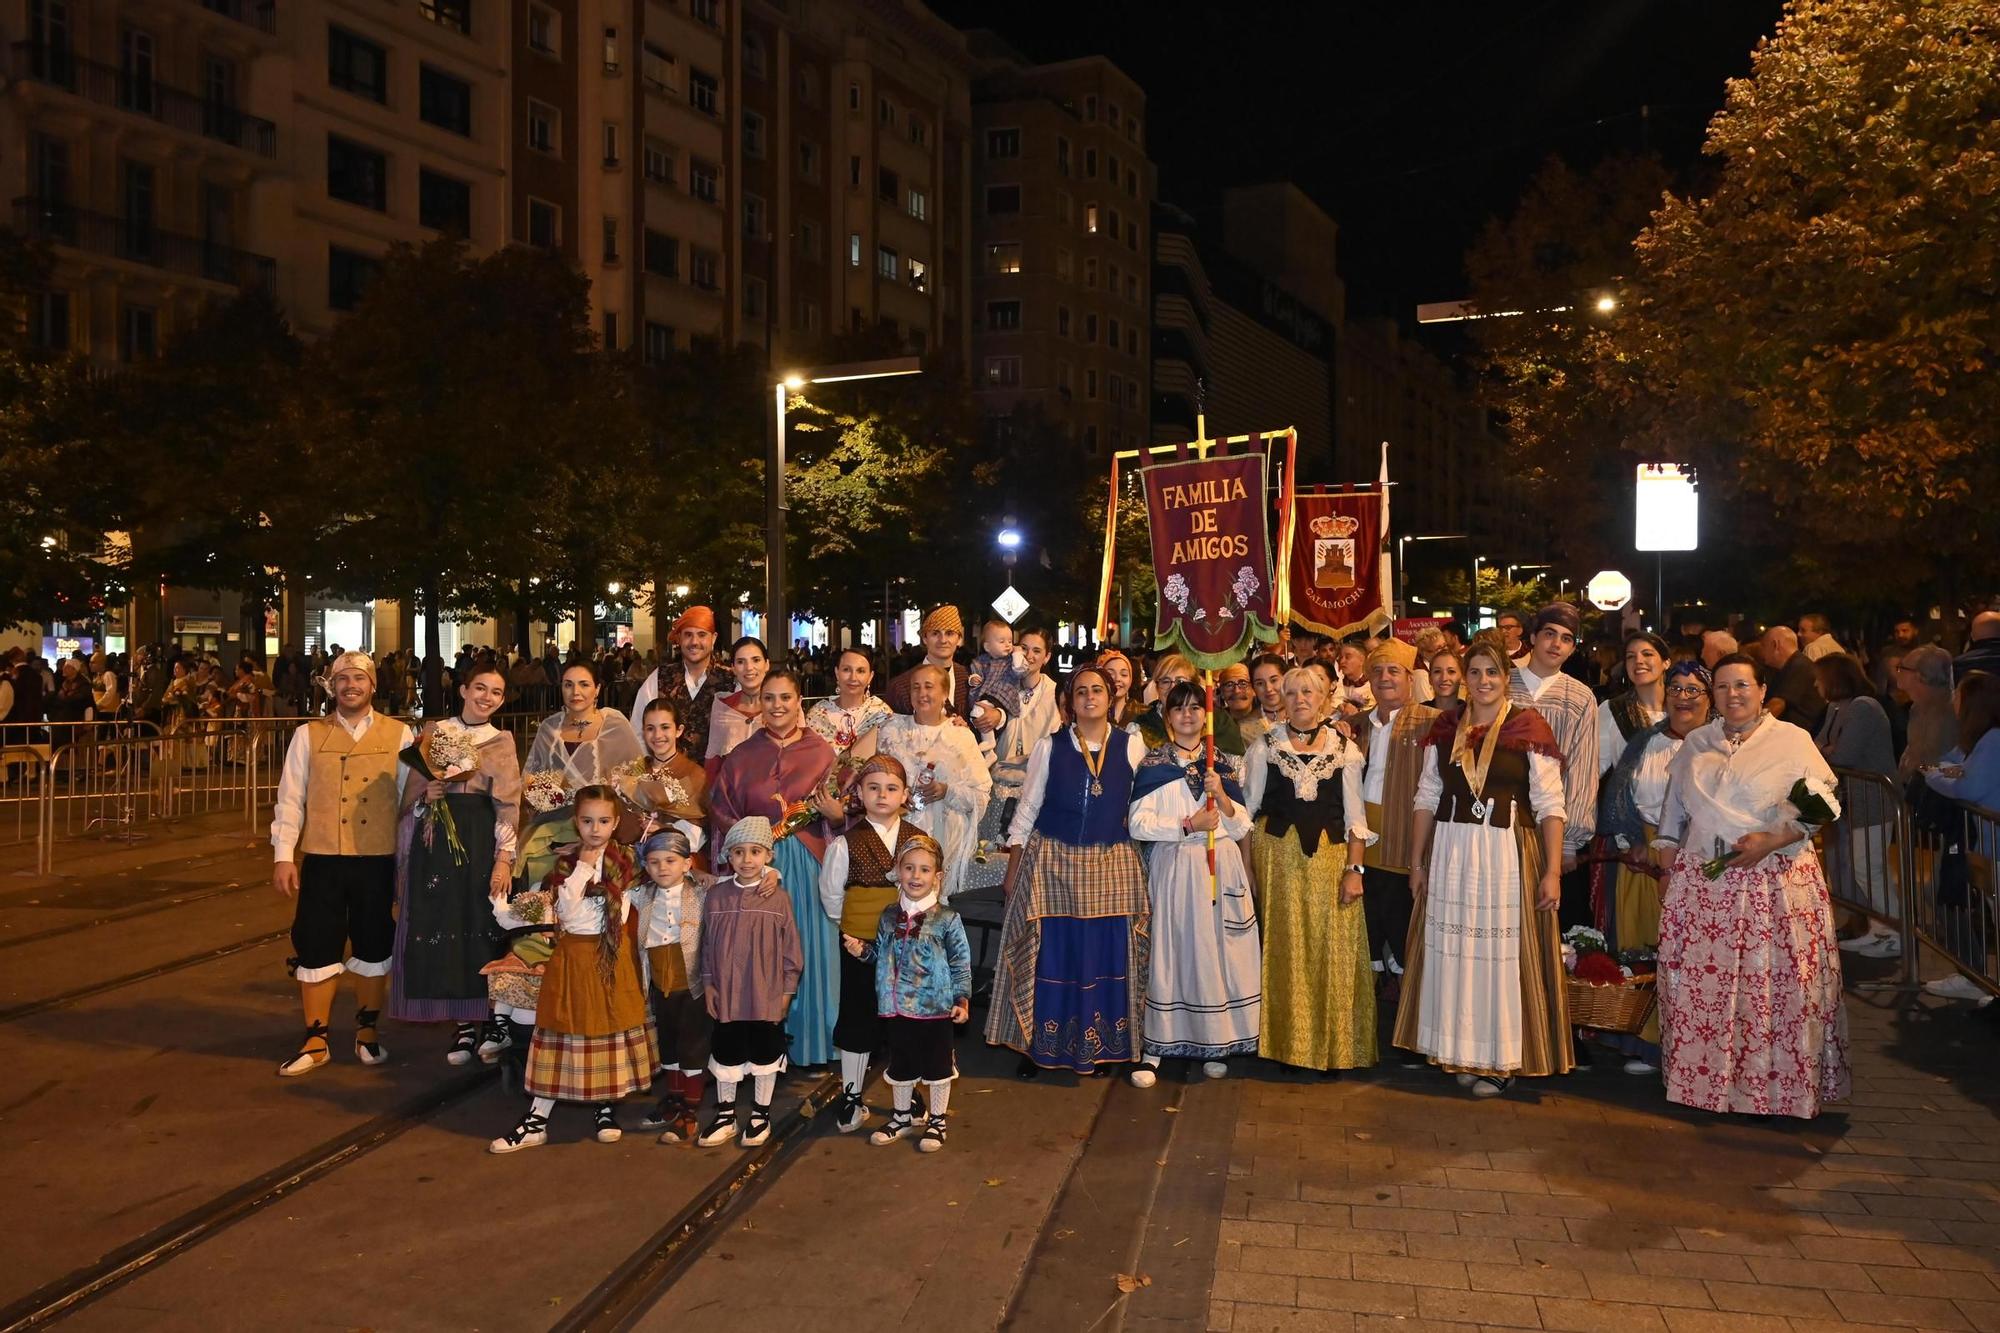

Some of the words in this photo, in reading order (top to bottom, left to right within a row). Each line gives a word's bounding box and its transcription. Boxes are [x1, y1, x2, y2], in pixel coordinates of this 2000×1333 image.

[1162, 477, 1248, 510] FAMILIA
[1191, 508, 1218, 533] DE
[1169, 535, 1249, 565] AMIGOS
[1305, 587, 1365, 609] CALAMOCHA
[57, 638, 80, 648] Todo
